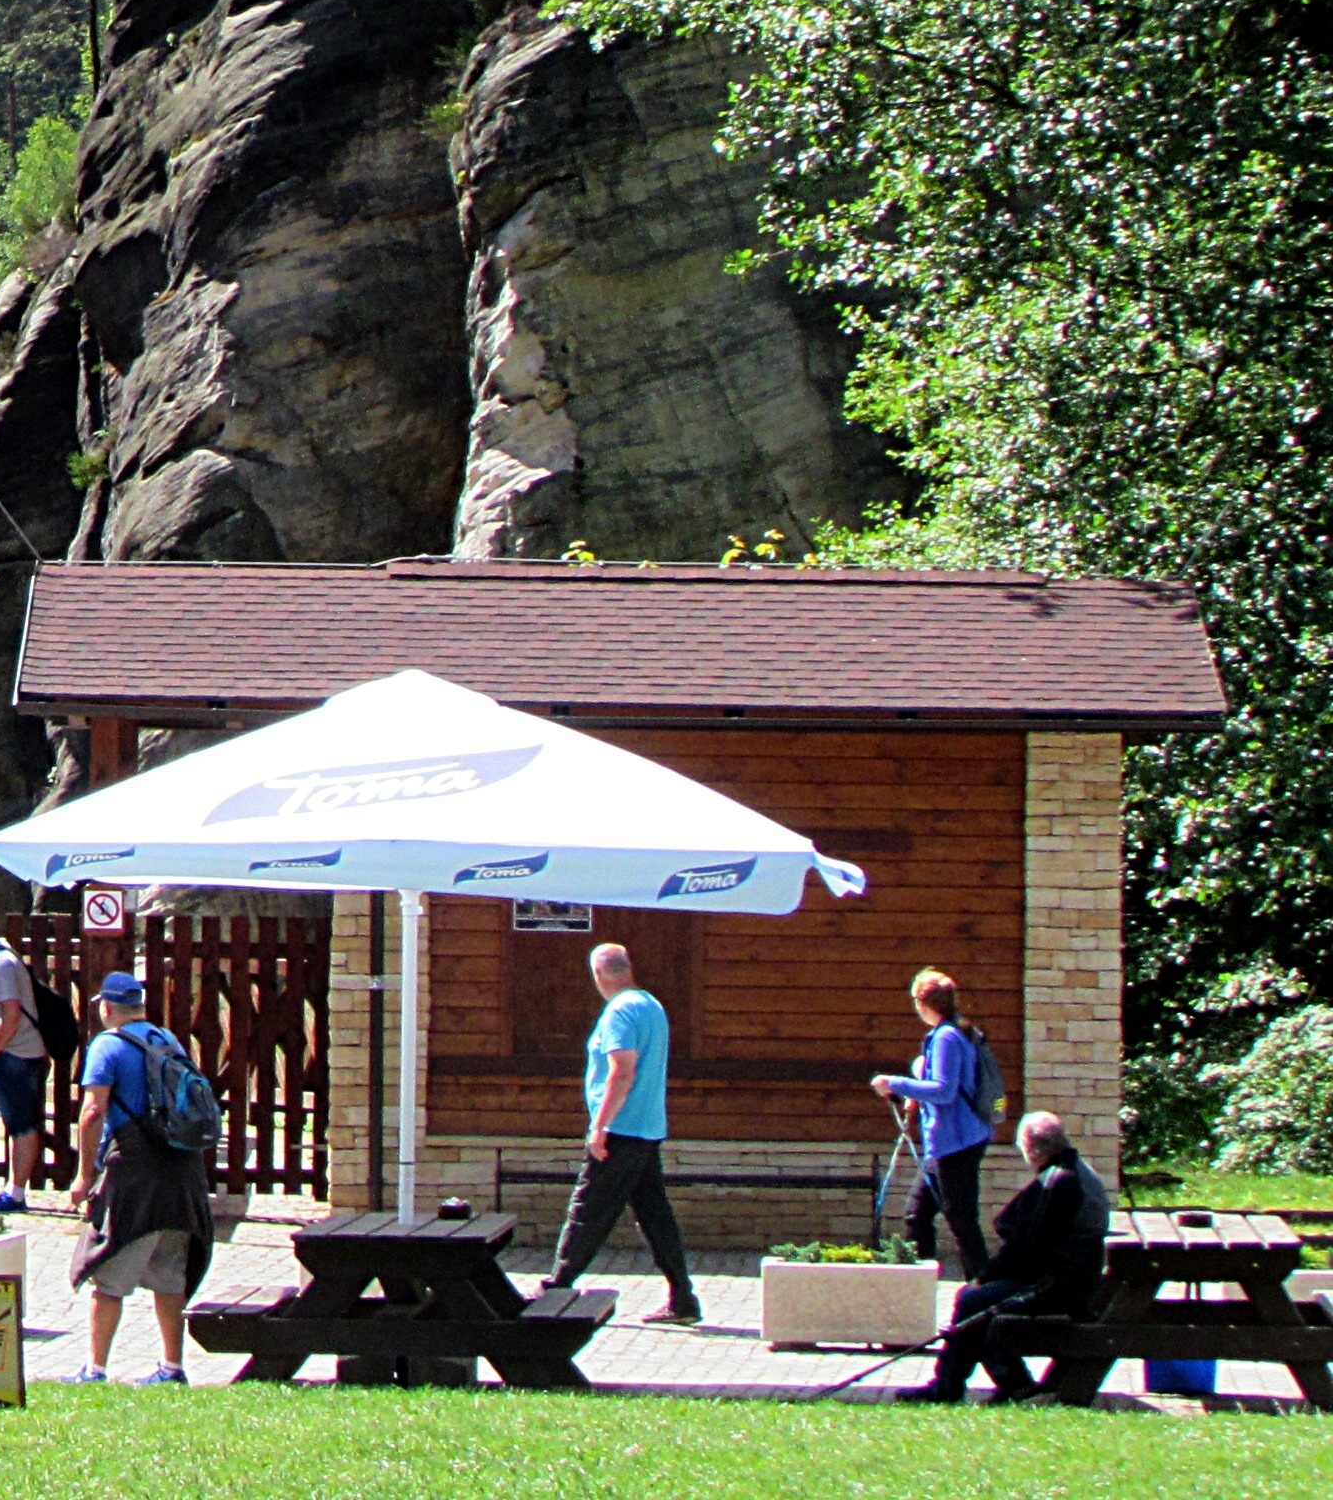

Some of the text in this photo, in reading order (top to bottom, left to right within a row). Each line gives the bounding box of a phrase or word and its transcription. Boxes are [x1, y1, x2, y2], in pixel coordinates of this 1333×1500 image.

[263, 762, 481, 816] Toma
[469, 864, 532, 880] Toma
[675, 869, 741, 895] Toma
